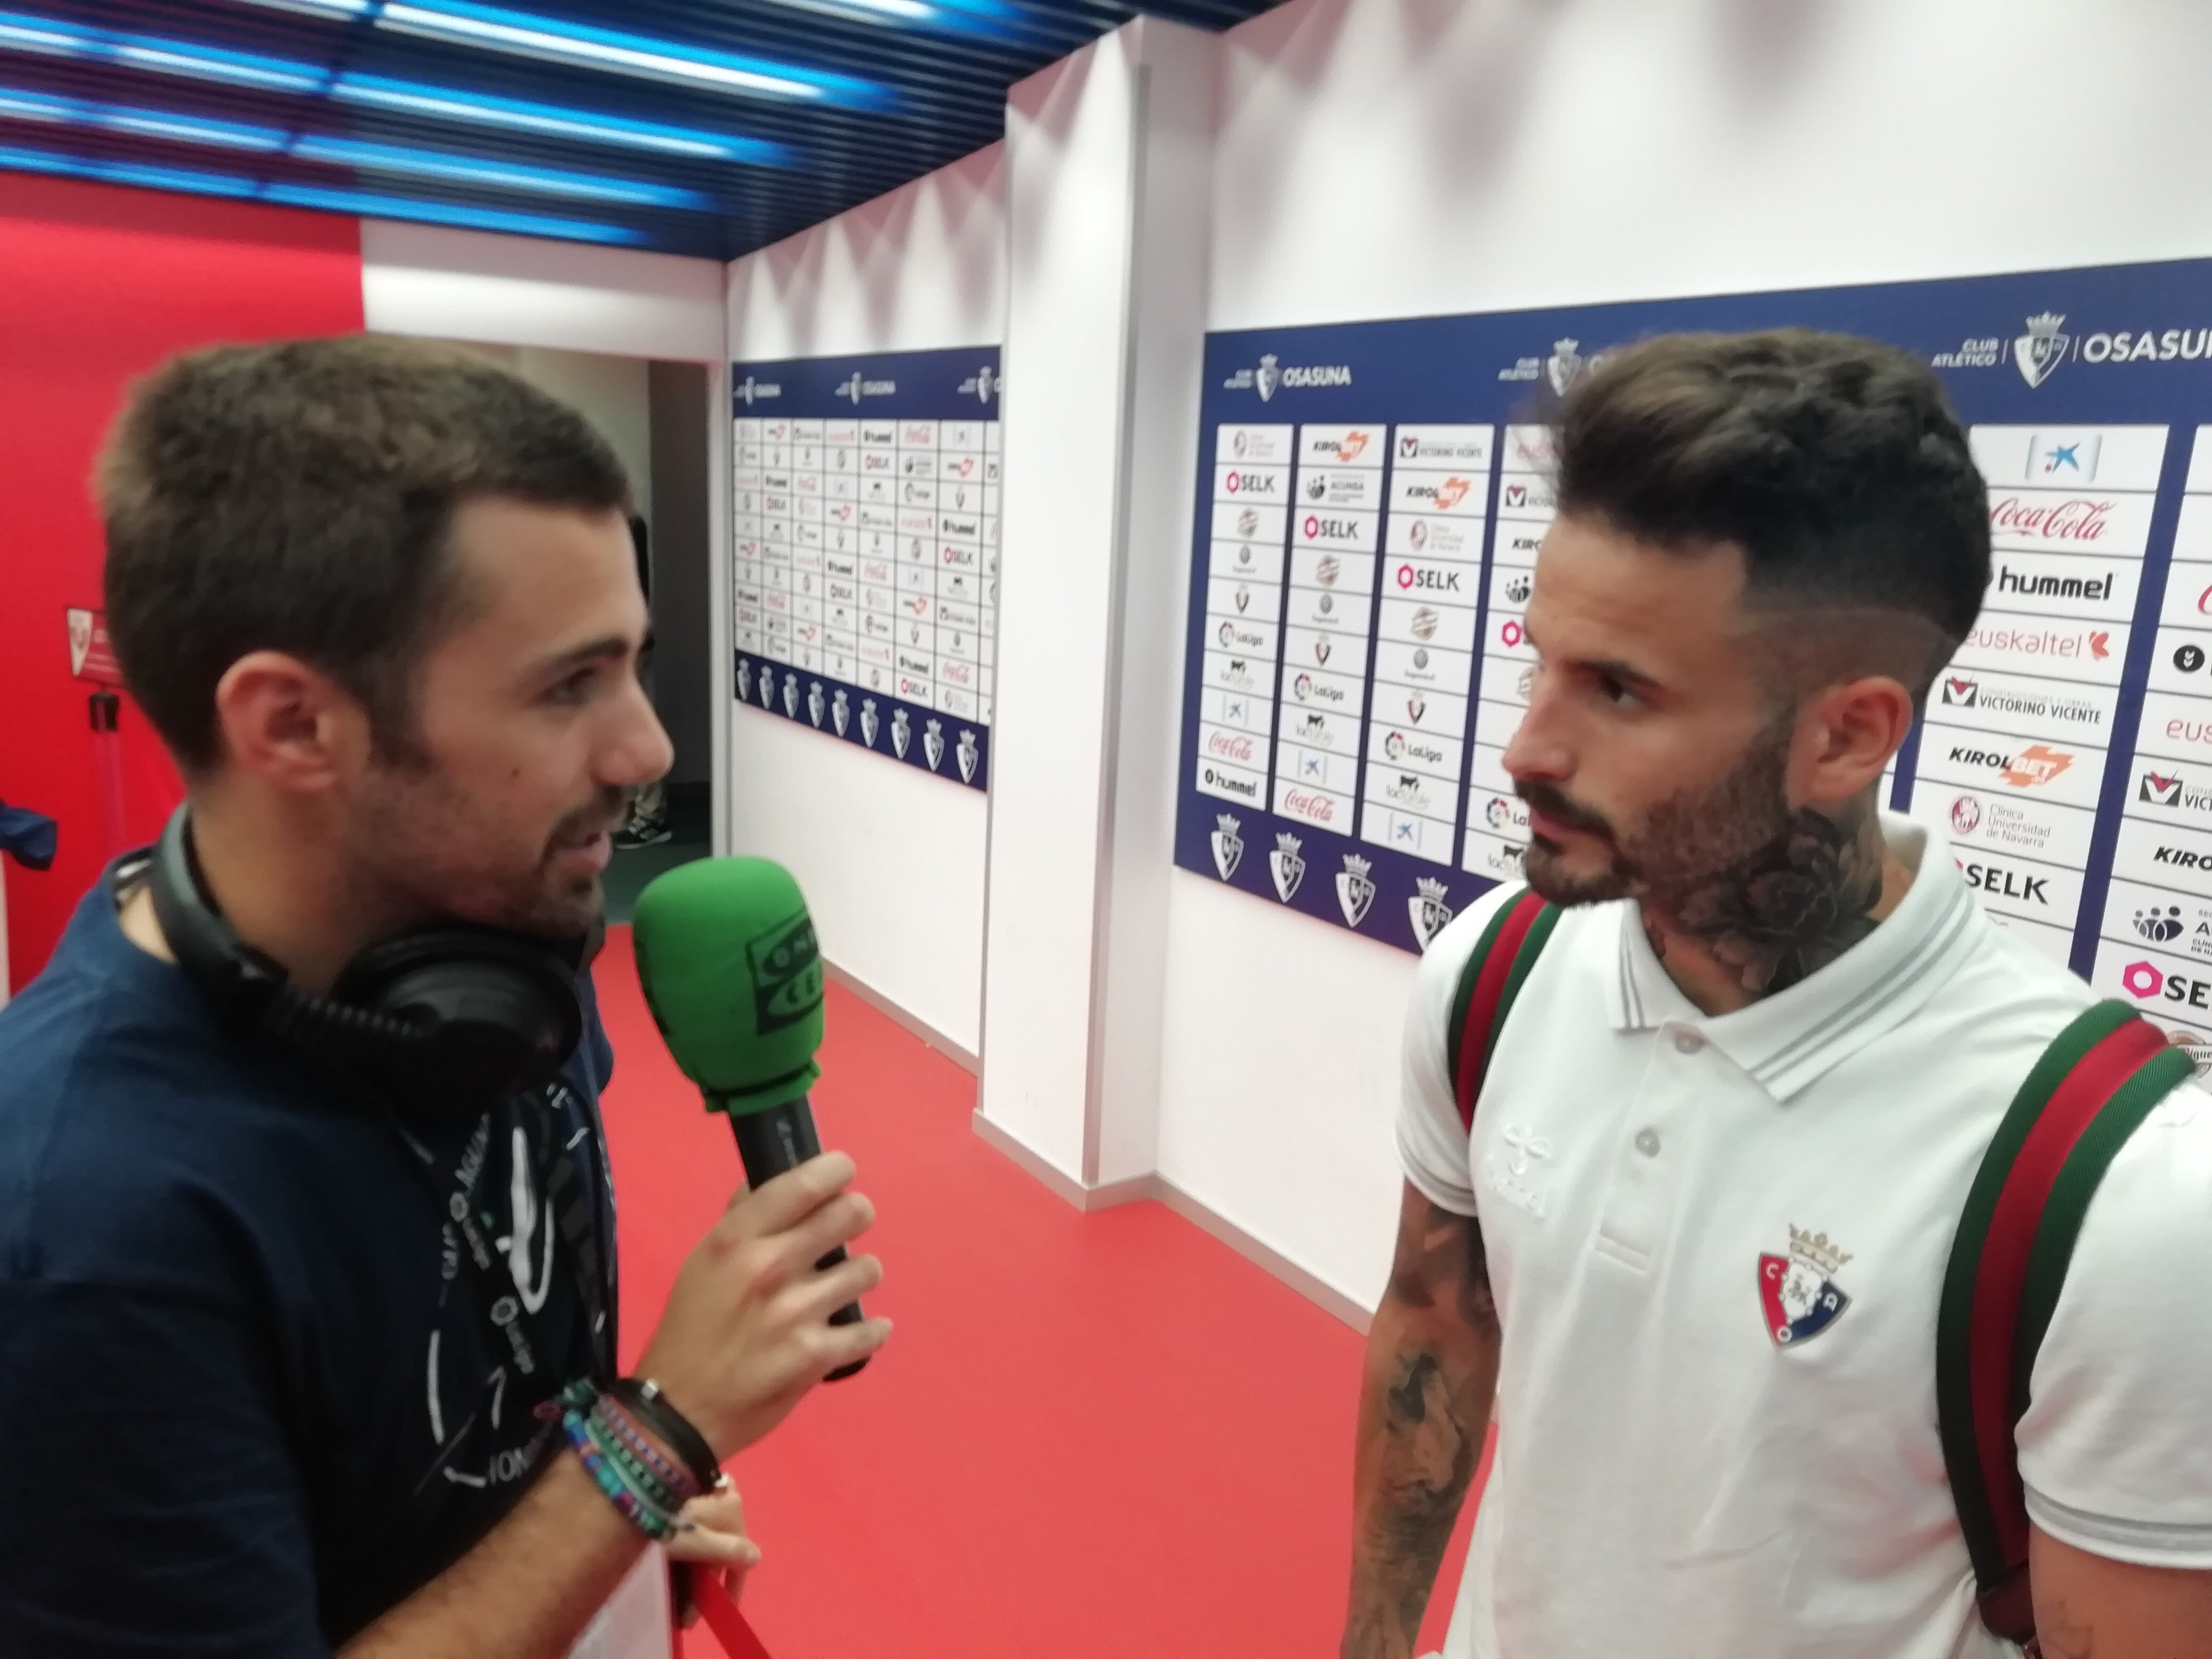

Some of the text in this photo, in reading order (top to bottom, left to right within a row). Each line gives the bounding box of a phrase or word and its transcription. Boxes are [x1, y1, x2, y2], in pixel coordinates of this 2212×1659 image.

[1283, 365, 1352, 387] OSASUNA
[1320, 519, 1359, 540] SELK
[1415, 568, 1460, 592] SELK
[1998, 564, 2113, 601] hummel
[1980, 694, 2101, 724] VICTORINO VICENTE
[1987, 826, 2044, 848] de Navarra
[1988, 815, 2051, 837] Universidad
[1966, 863, 2049, 906] SELK
